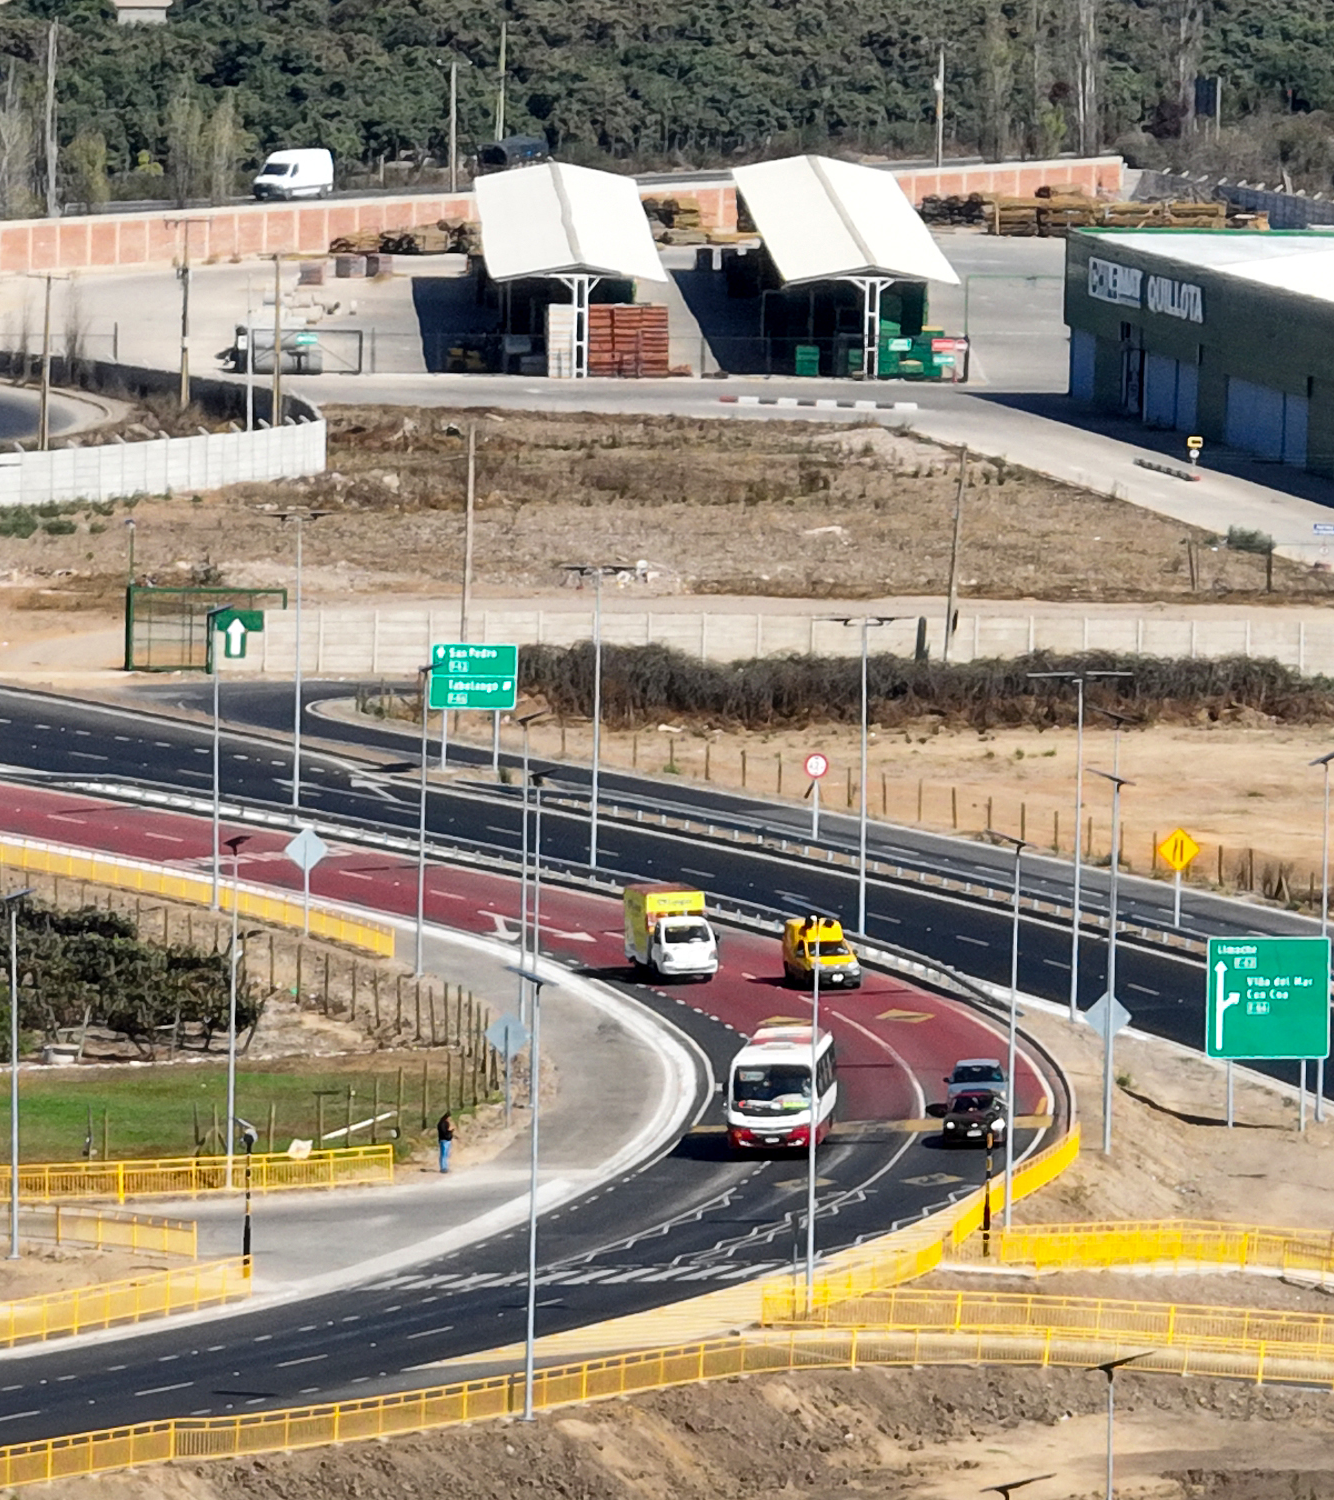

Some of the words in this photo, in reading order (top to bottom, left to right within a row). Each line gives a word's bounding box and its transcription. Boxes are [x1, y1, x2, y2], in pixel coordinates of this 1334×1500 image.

[1147, 275, 1203, 323] QUILLOTA
[449, 647, 467, 659] San
[469, 647, 498, 659] Pedro
[449, 680, 499, 693] Tabolango
[1217, 945, 1257, 955] Limache
[1274, 976, 1290, 986] del
[1294, 976, 1313, 987] Mar
